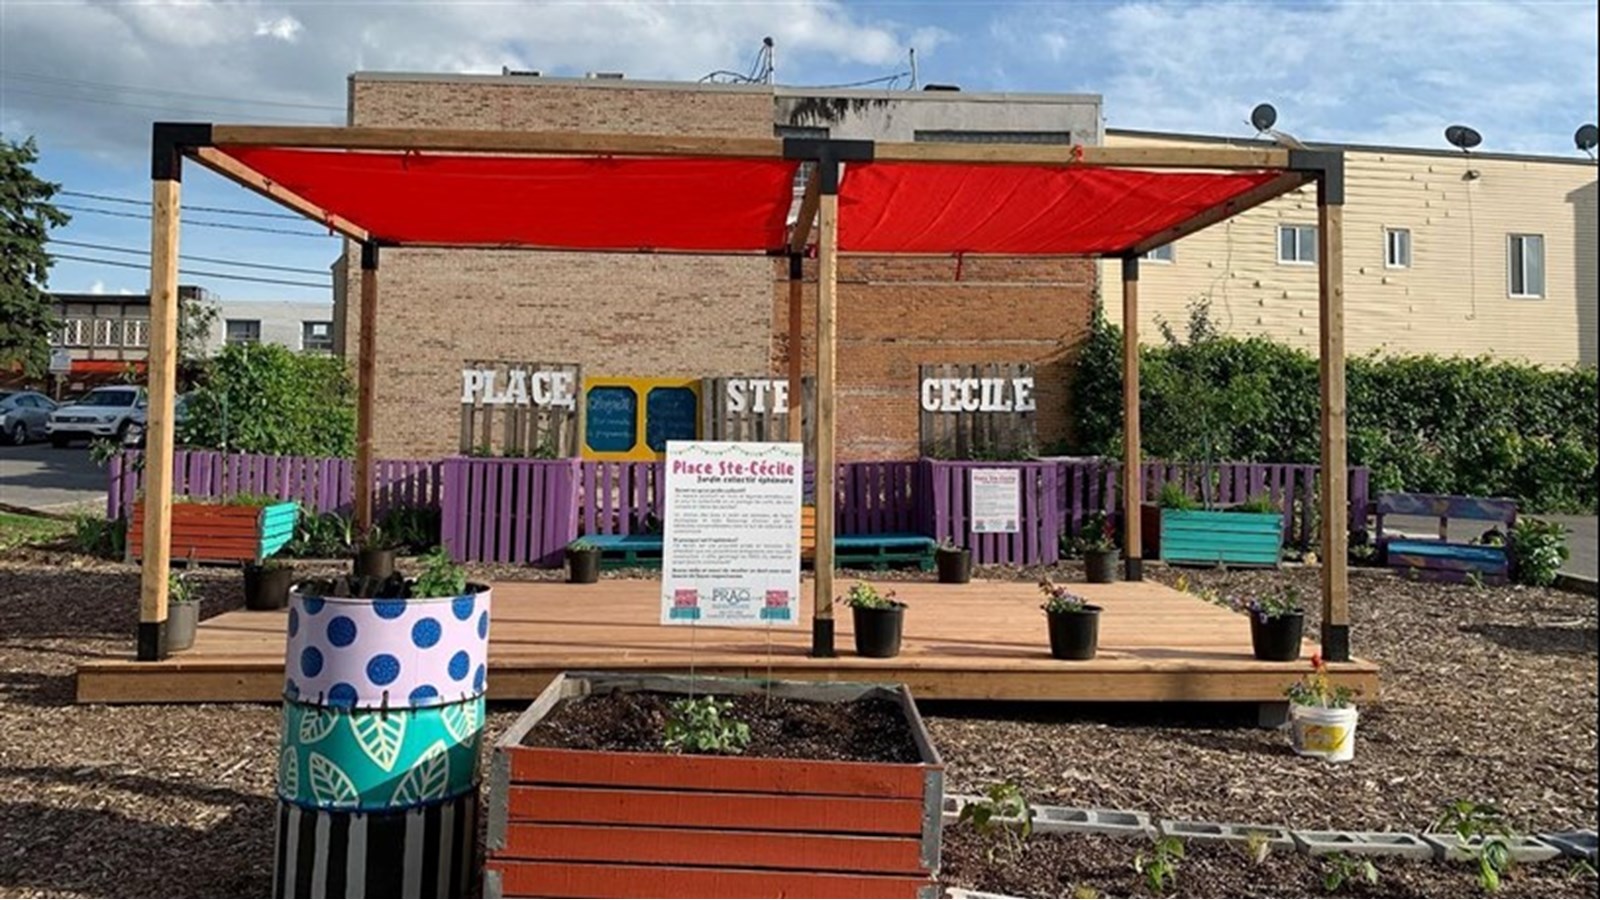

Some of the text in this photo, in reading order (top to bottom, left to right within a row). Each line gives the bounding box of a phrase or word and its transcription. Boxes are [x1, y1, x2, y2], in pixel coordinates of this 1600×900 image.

[461, 369, 576, 411] PLACE
[727, 379, 789, 413] STE
[922, 377, 1036, 412] CECILE
[673, 460, 795, 476] Place Ste-Cécile
